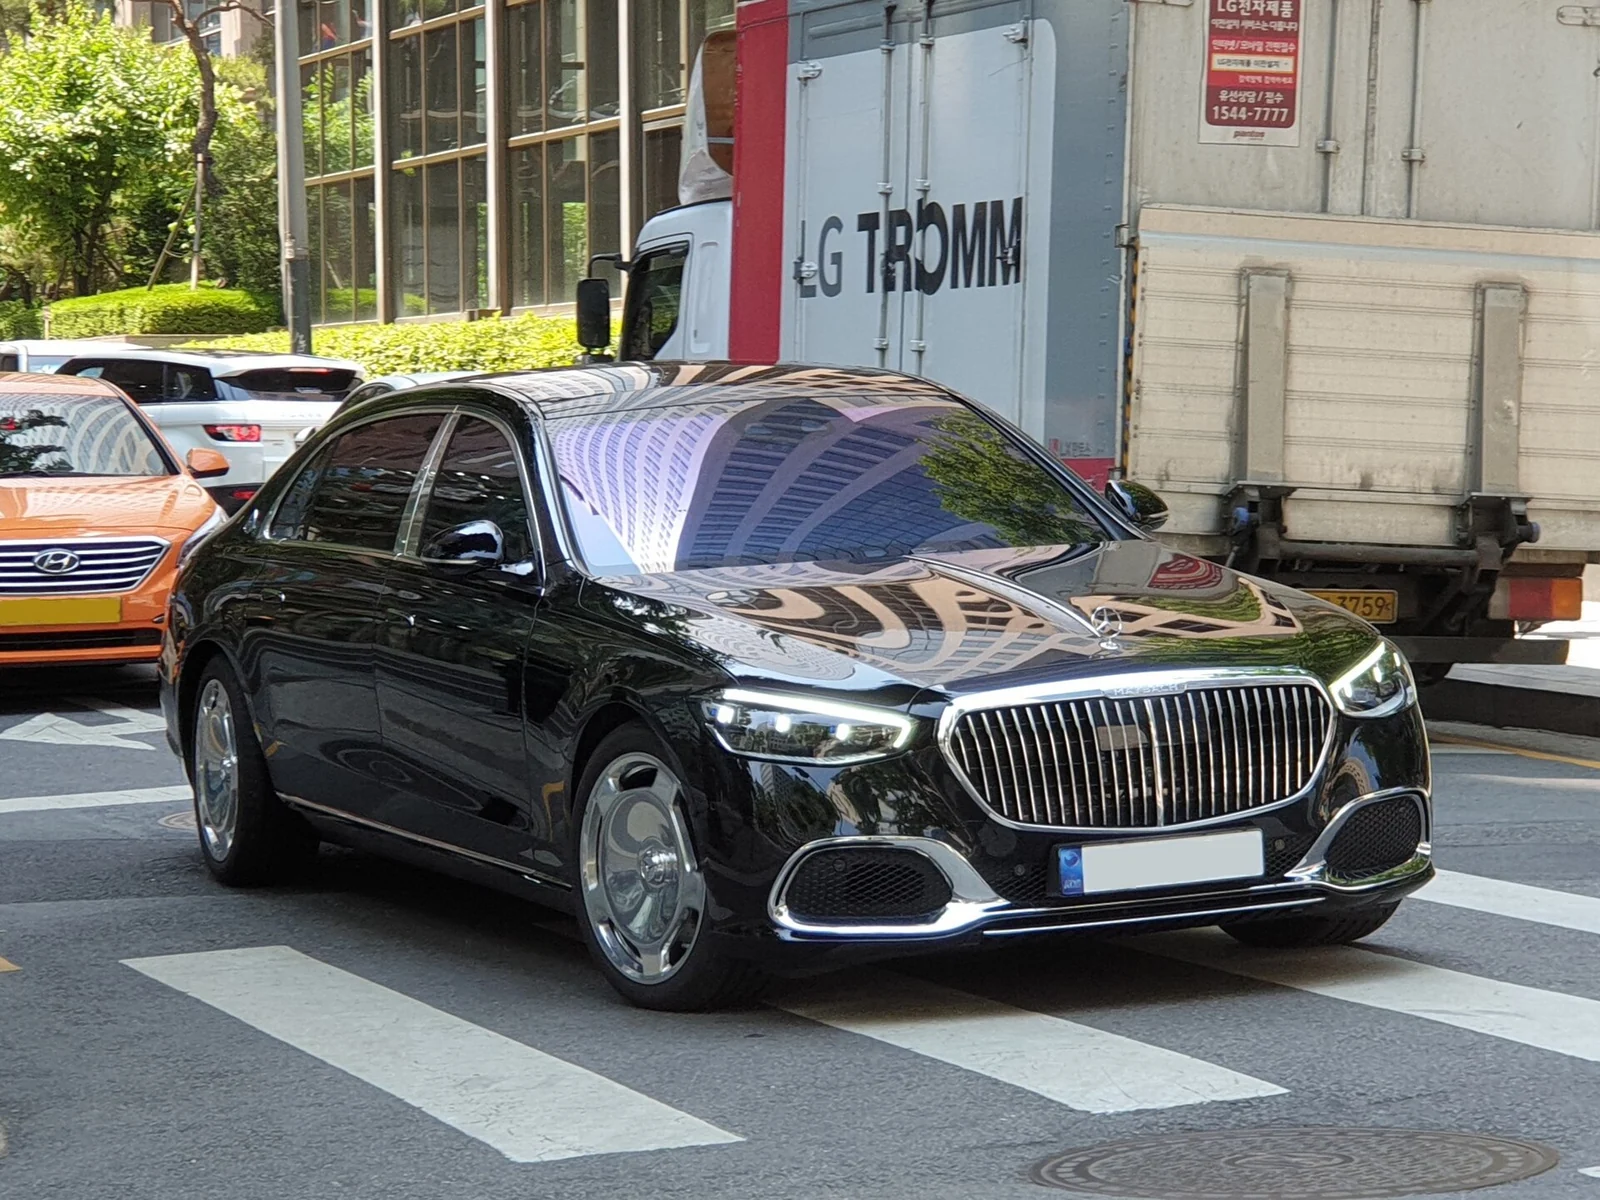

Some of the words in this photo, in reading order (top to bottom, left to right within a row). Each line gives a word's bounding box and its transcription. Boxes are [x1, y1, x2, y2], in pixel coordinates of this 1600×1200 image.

[1212, 105, 1289, 122] 1544-7777
[800, 215, 844, 298] LG
[857, 197, 1023, 296] TROMM
